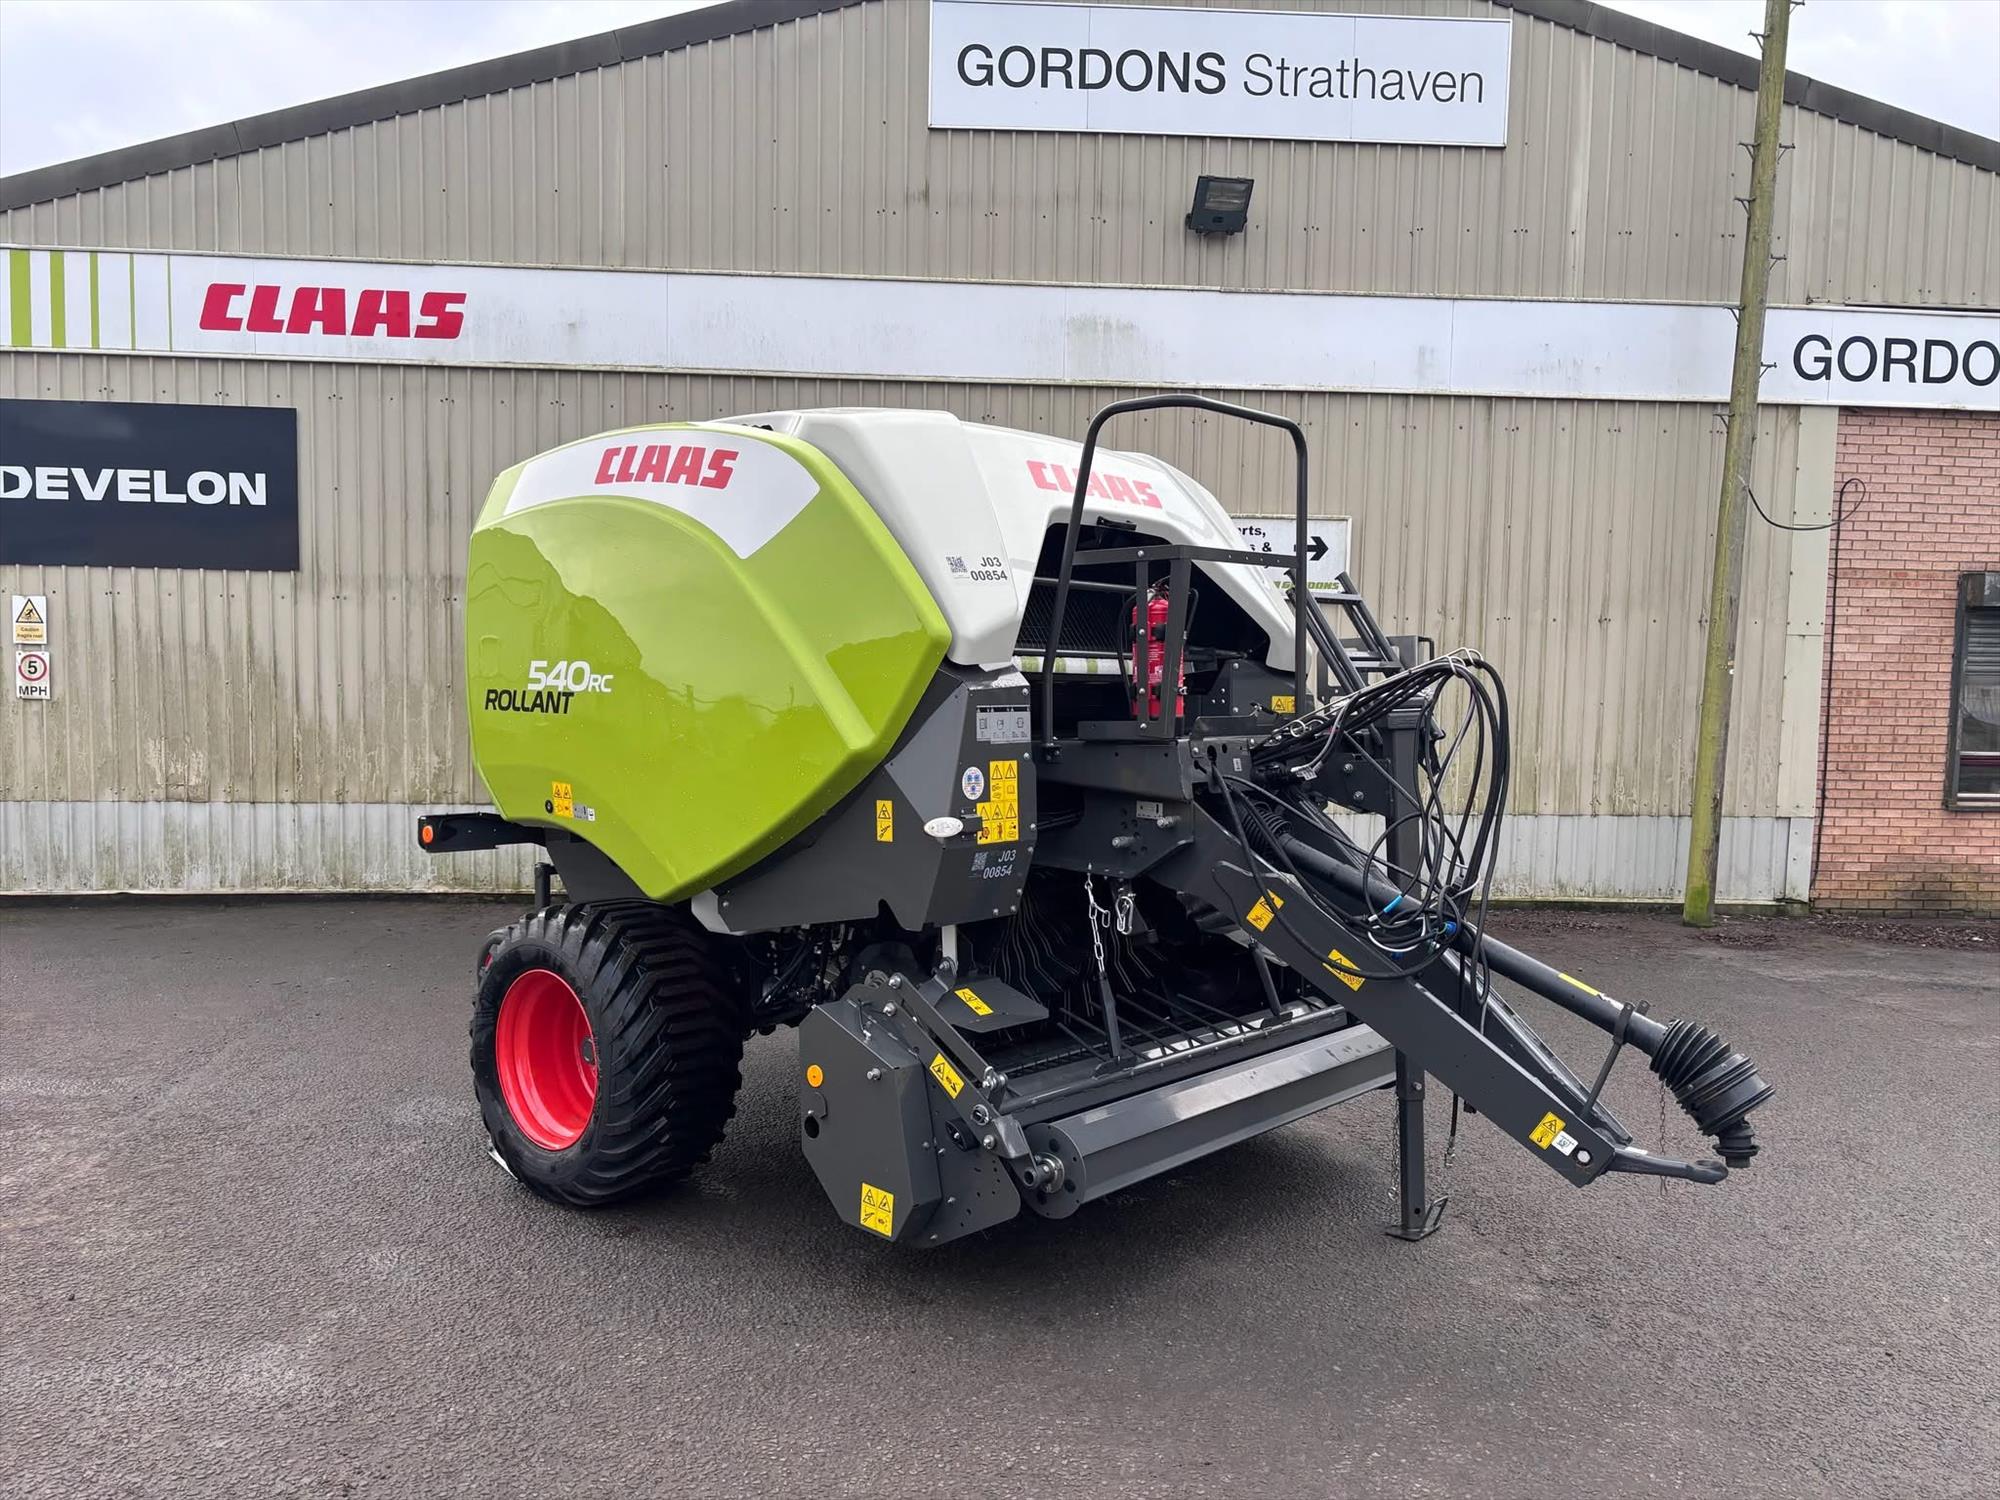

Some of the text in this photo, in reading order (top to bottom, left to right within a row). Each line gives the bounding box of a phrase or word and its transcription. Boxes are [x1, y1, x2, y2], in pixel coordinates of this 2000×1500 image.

[957, 43, 1485, 104] GORDONS Strathaven
[199, 283, 467, 339] CLAAS
[595, 445, 739, 490] CLAAS
[0, 466, 266, 506] DEVELON
[981, 557, 1002, 567] J03
[970, 570, 1008, 581] 00854
[27, 661, 38, 675] 5
[19, 685, 47, 696] MPH
[485, 689, 574, 714] ROLLANT
[998, 850, 1017, 863] J03
[983, 864, 1013, 879] 00854
